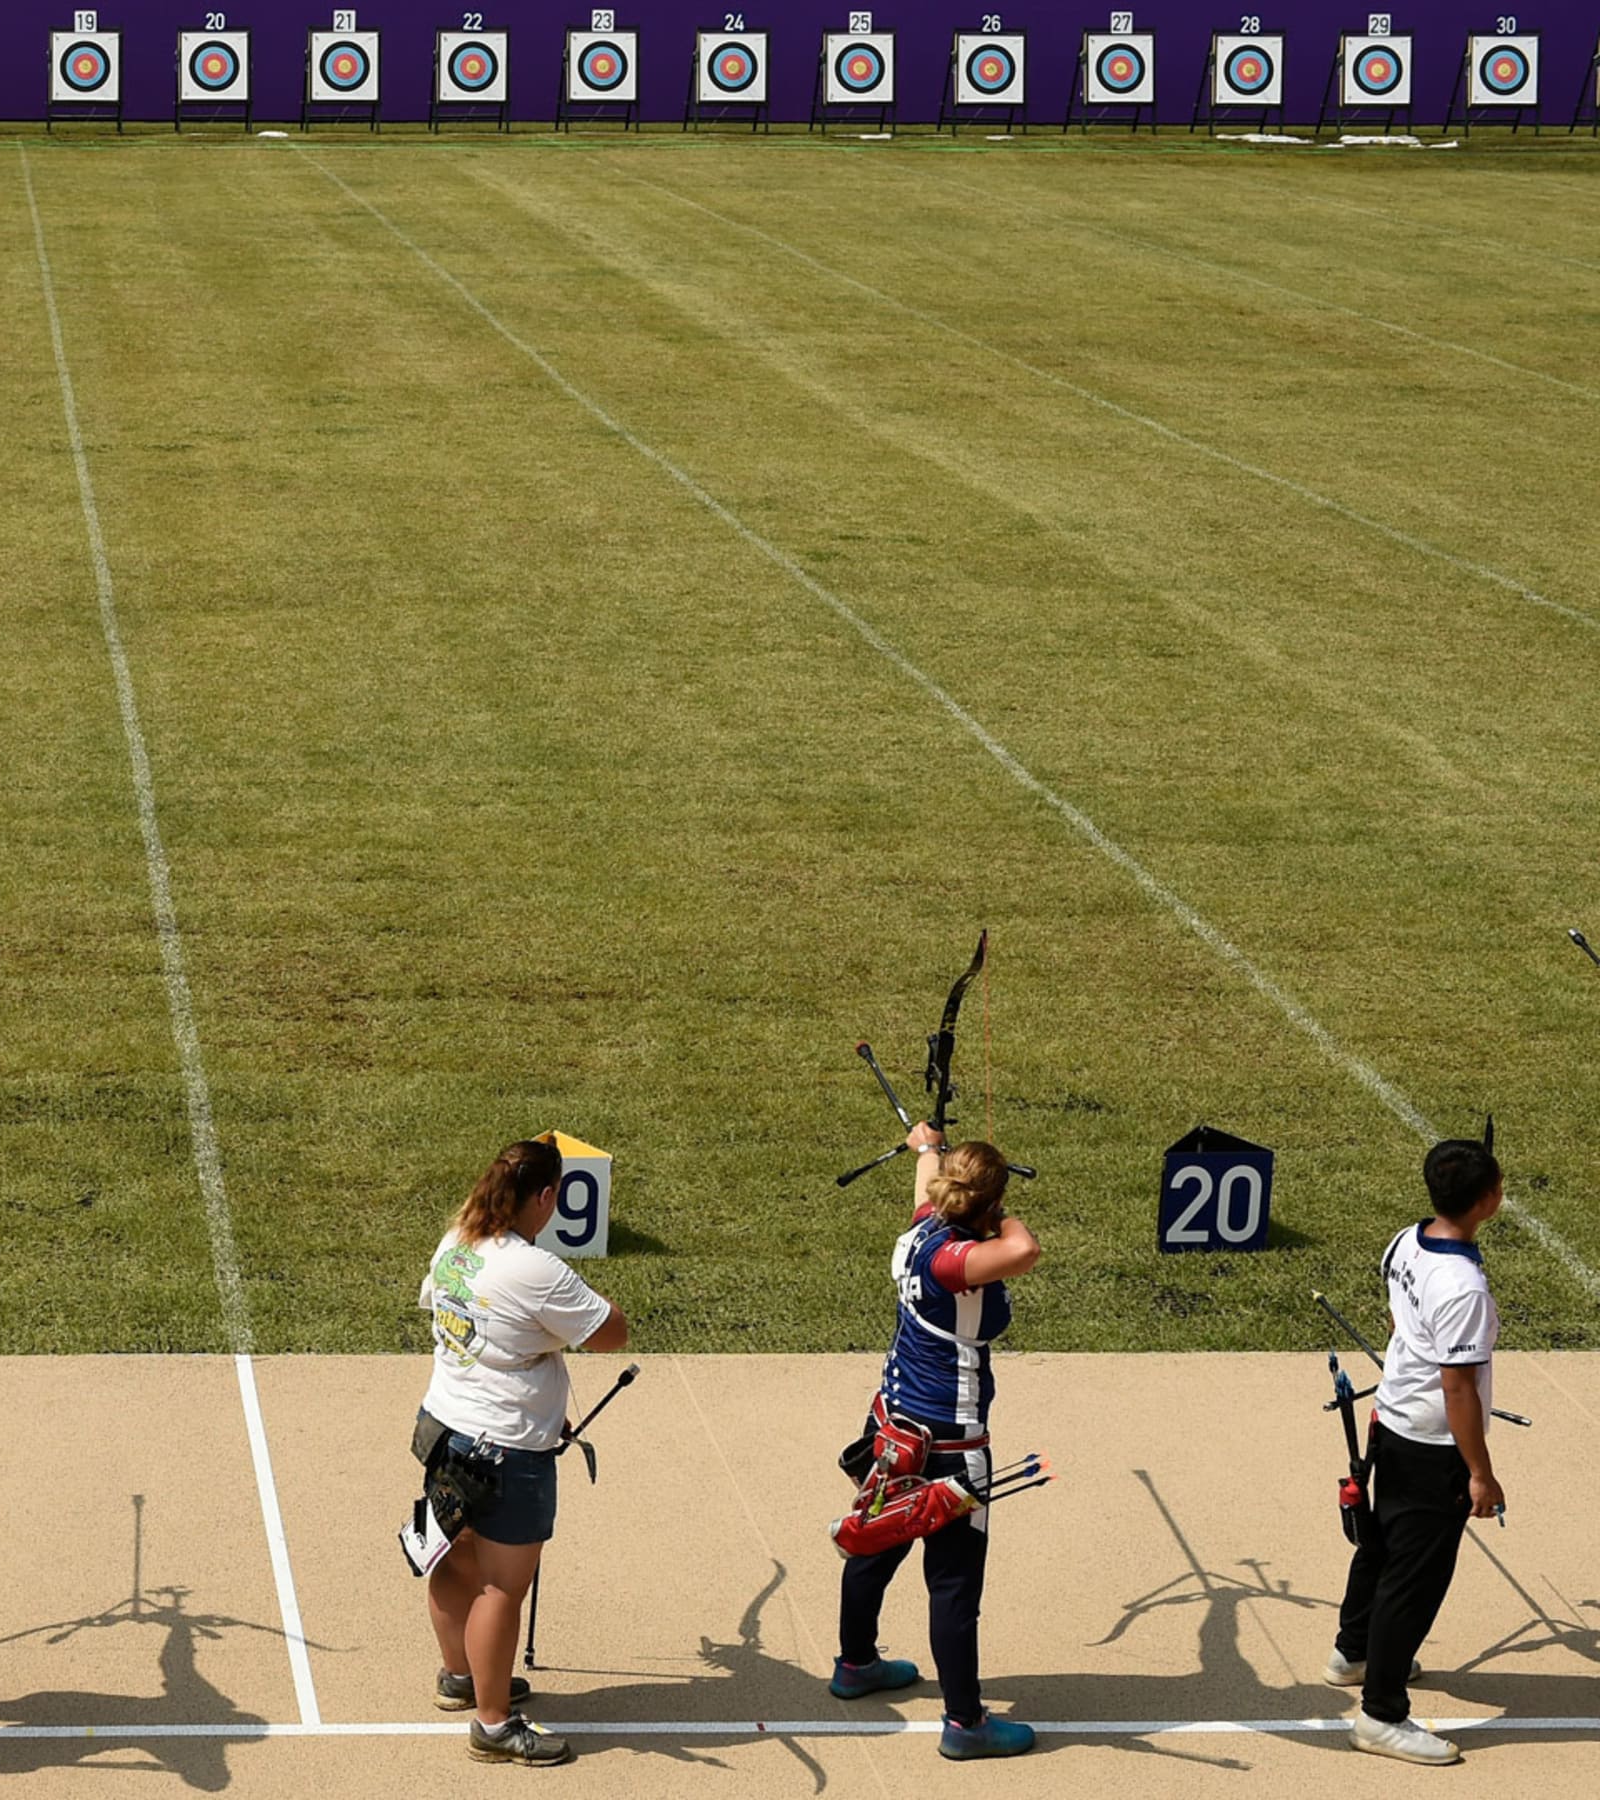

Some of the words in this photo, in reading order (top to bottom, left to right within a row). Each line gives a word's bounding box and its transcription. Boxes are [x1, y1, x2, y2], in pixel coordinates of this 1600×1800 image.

[77, 14, 94, 31] 19
[205, 13, 225, 30] 20
[336, 13, 353, 31] 21
[463, 13, 483, 31] 22
[594, 13, 612, 30] 23
[725, 14, 745, 31] 24
[851, 15, 870, 32] 25
[982, 15, 1001, 32] 26
[1113, 15, 1130, 32] 27
[1241, 16, 1260, 34] 28
[1371, 17, 1389, 34] 29
[1496, 17, 1516, 34] 30
[556, 1169, 599, 1247] 9
[1166, 1164, 1263, 1243] 20
